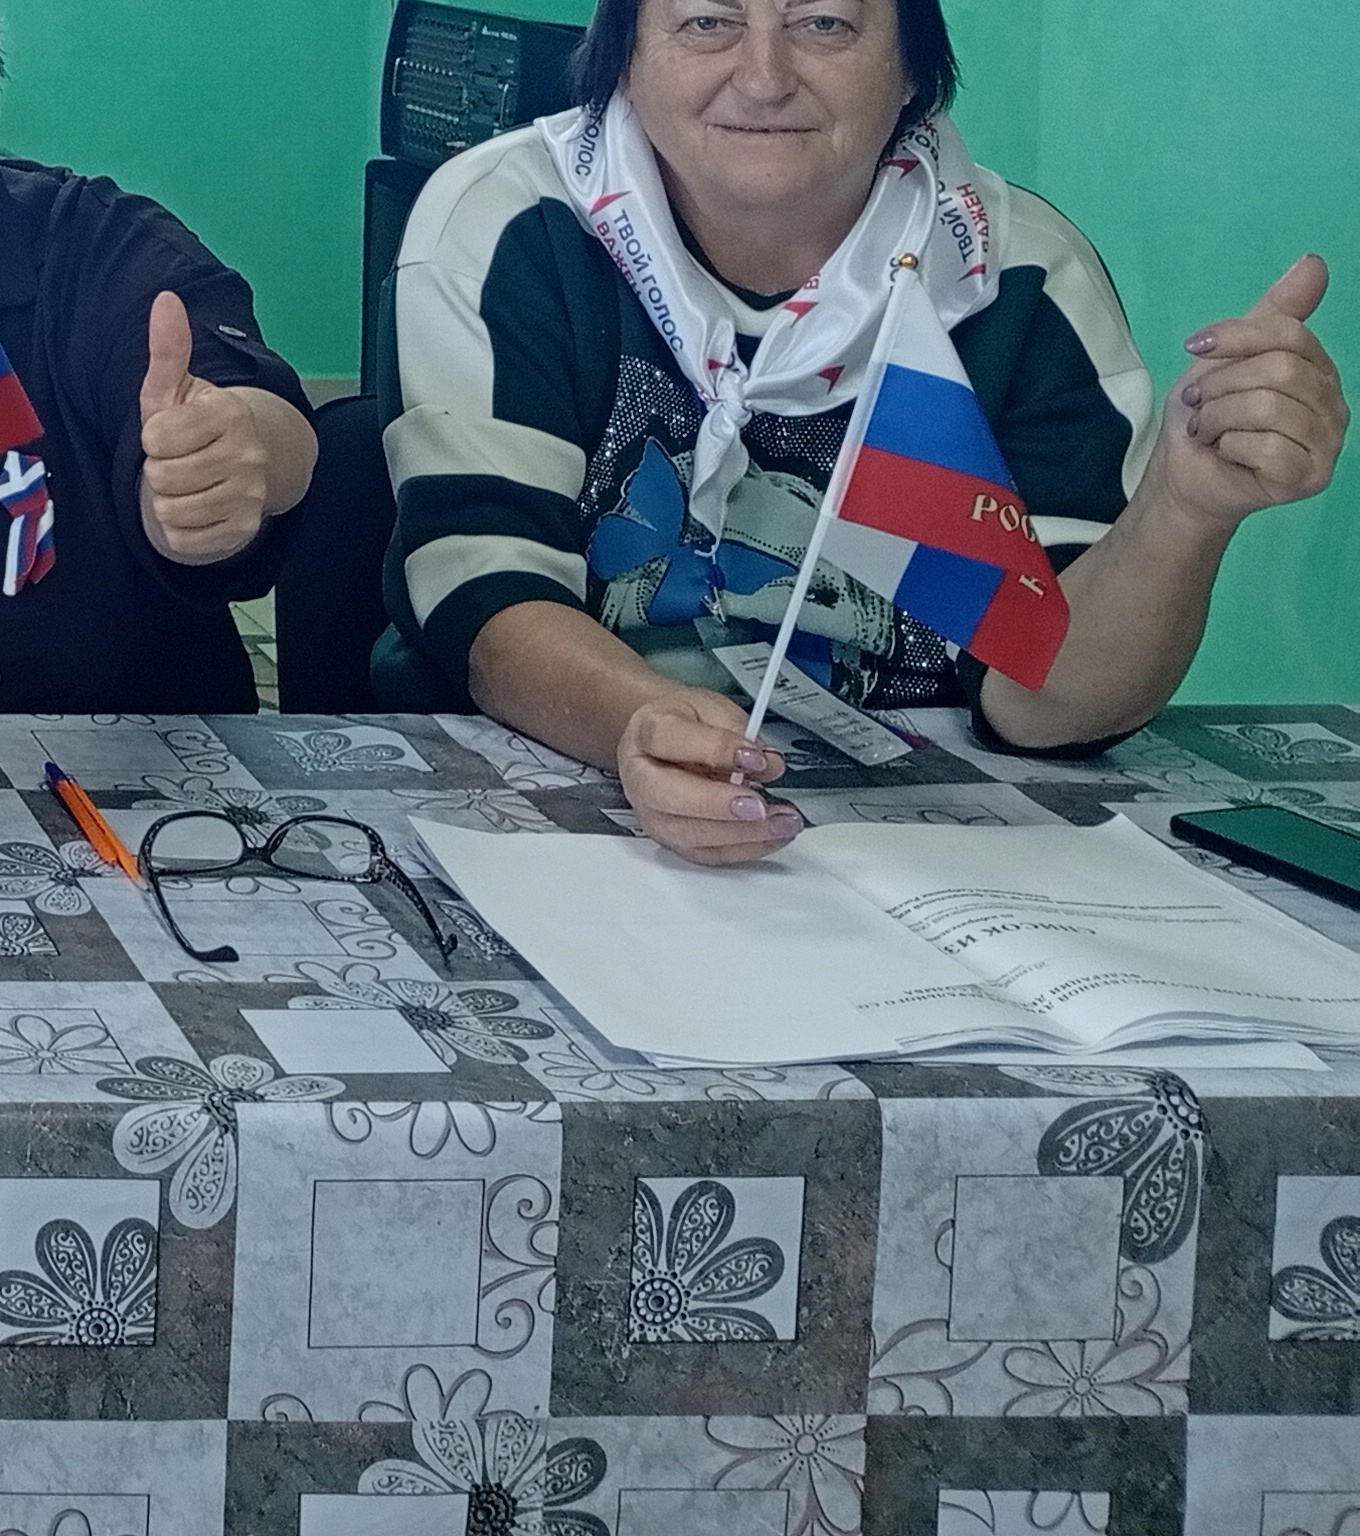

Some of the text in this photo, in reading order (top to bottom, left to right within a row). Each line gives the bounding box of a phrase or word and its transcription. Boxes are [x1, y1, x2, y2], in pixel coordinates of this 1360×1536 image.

[614, 209, 684, 353] ТВОЙ ГОЛОС
[939, 206, 976, 264] ТВОЙ
